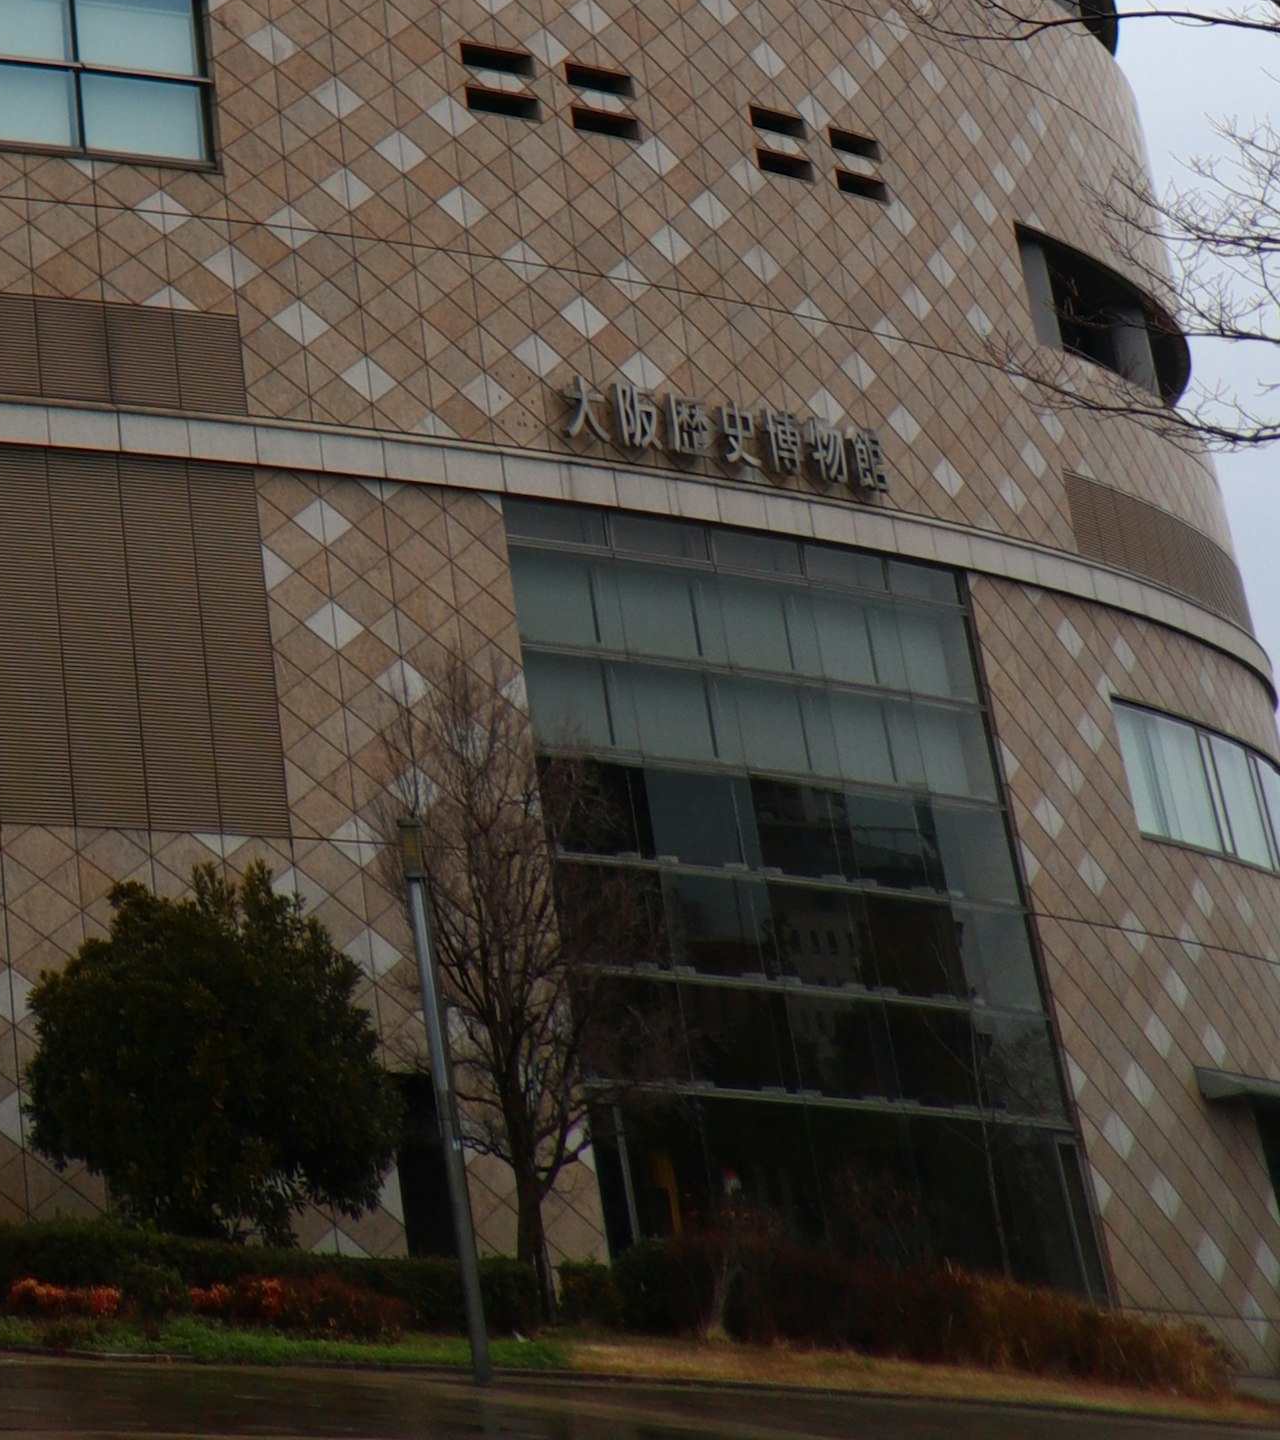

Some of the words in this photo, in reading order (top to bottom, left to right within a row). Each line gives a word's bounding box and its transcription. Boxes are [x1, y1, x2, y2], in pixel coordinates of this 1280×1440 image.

[561, 374, 890, 494] 大阪歴史博物館
